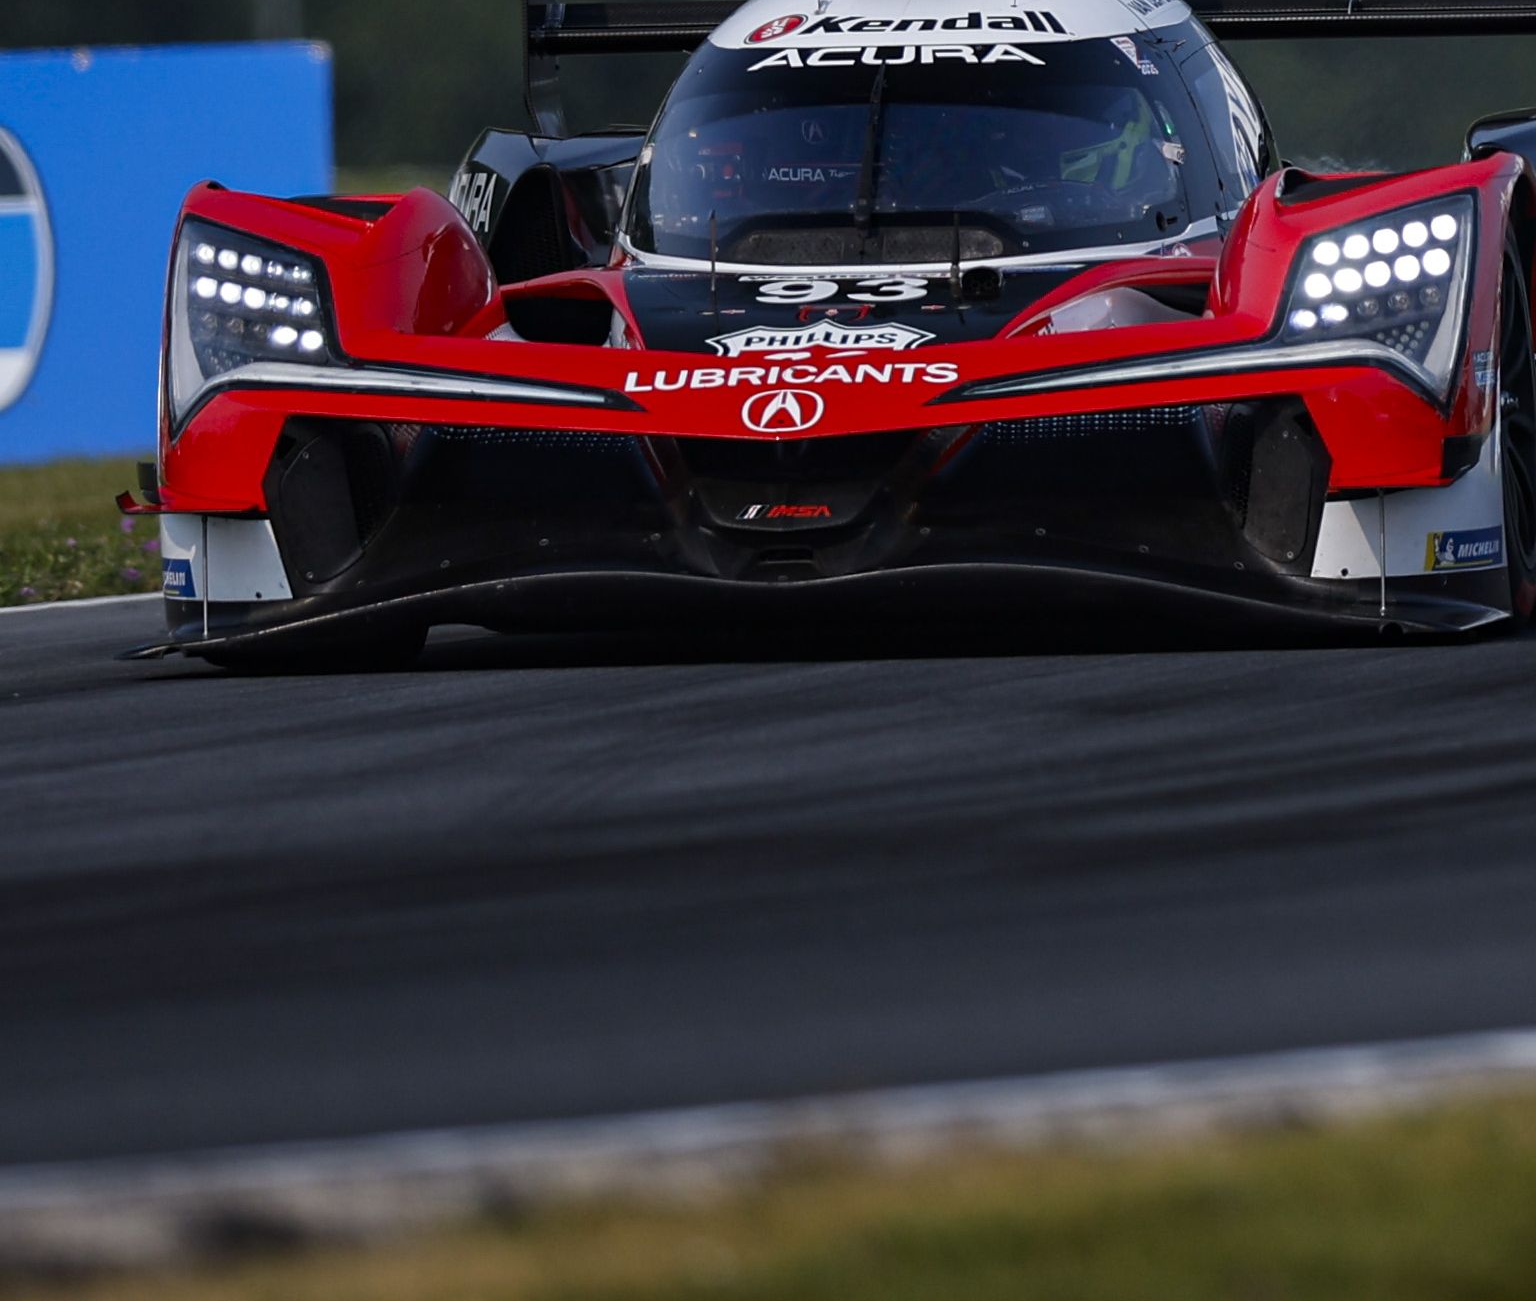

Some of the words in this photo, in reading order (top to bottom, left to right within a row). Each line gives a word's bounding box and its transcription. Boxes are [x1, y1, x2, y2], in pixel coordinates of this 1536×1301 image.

[798, 10, 1069, 36] Kendall
[746, 43, 1047, 73] ACURA
[768, 167, 826, 183] ACURA
[755, 278, 929, 304] 93
[744, 330, 899, 350] PHILLIPS
[624, 362, 959, 393] LUBRICANTS
[766, 504, 833, 519] IMSA
[1457, 539, 1500, 559] MICHELIN
